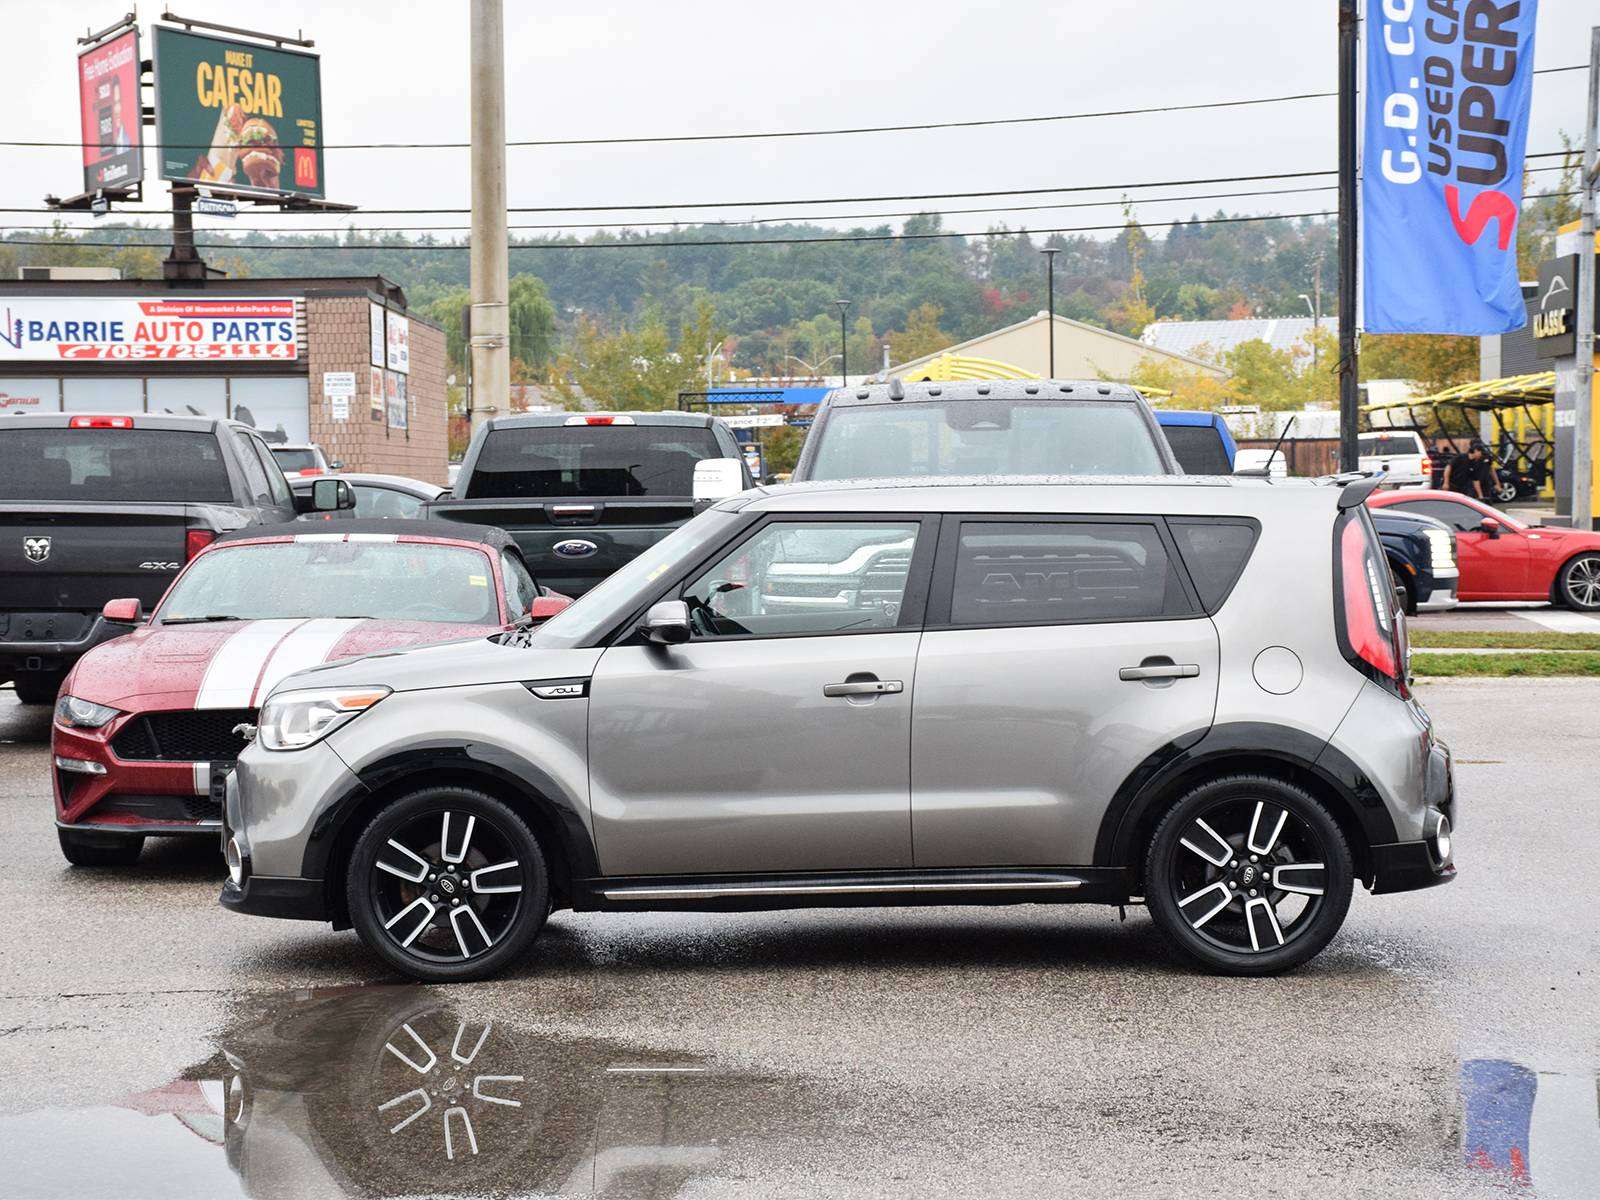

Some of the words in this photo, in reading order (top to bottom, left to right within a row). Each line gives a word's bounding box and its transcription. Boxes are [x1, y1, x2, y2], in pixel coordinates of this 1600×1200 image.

[197, 61, 283, 118] CAESAR
[1381, 77, 1422, 185] G.D.
[1423, 56, 1455, 176] USED
[156, 305, 183, 313] Division
[195, 305, 234, 313] Newmarket
[271, 305, 292, 314] Group
[28, 321, 124, 342] BARRIE
[133, 321, 204, 342] AUTO
[212, 321, 293, 342] PARTS
[96, 345, 290, 358] 705-725-1114
